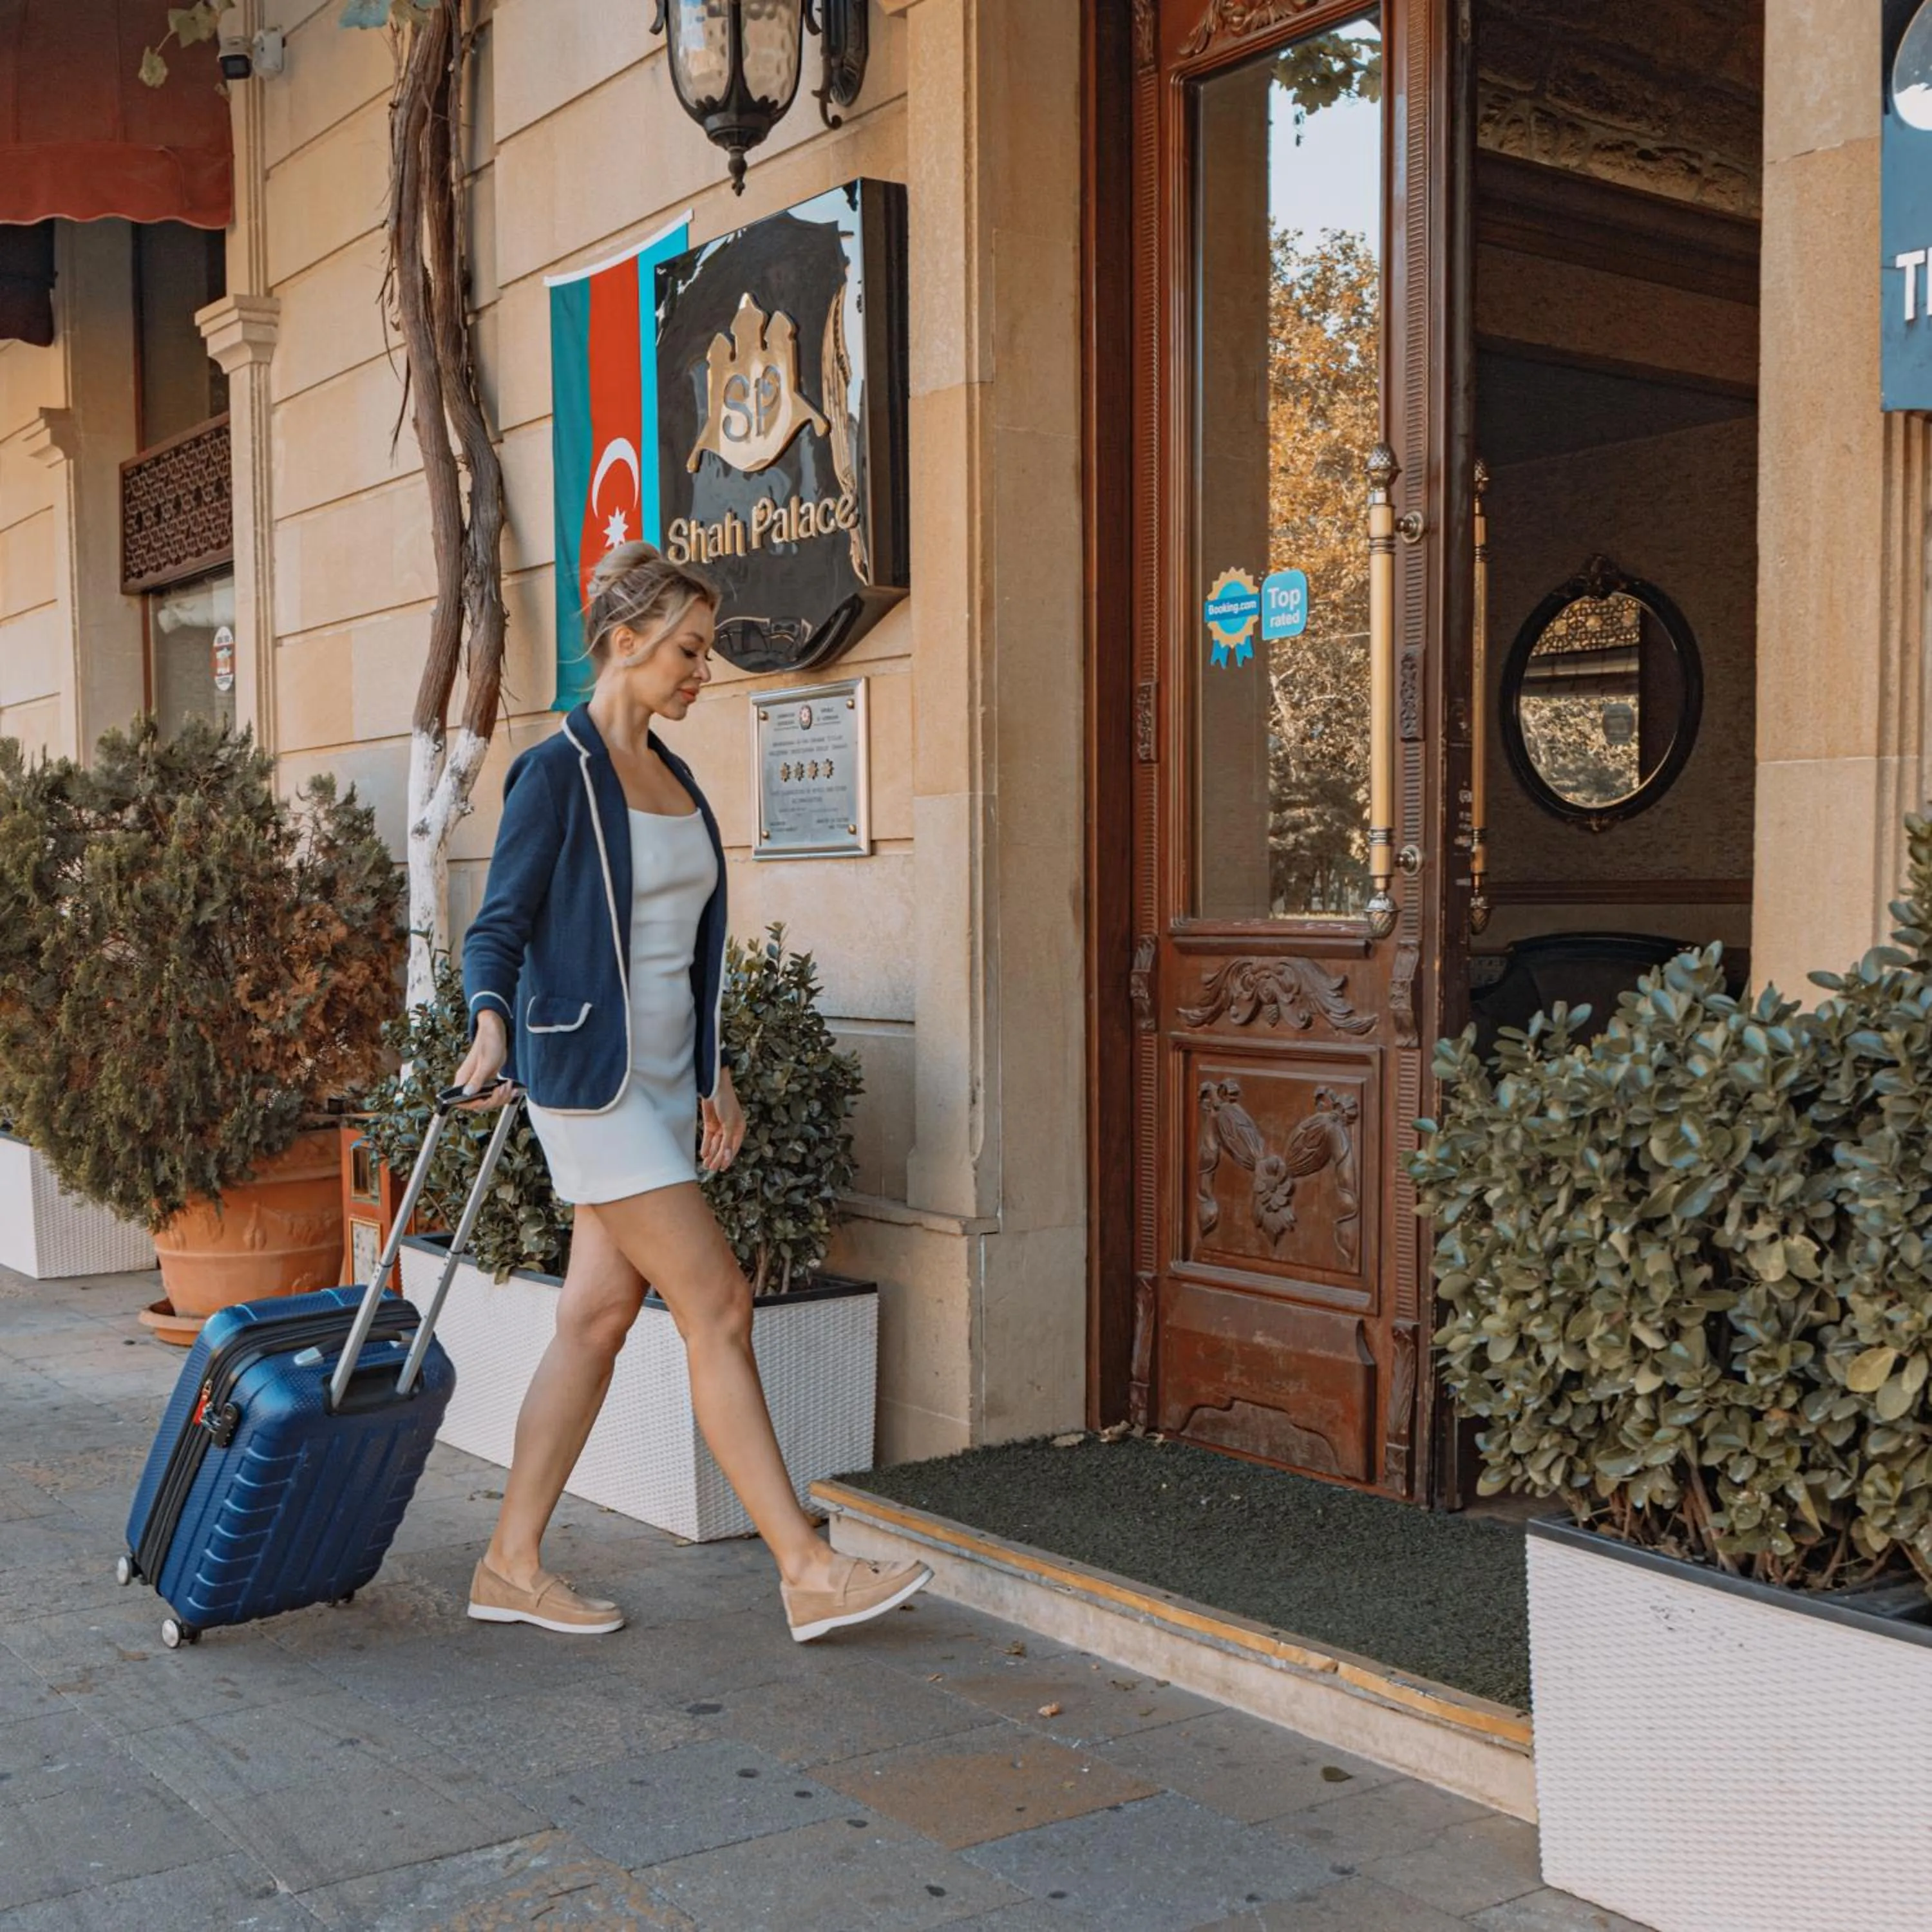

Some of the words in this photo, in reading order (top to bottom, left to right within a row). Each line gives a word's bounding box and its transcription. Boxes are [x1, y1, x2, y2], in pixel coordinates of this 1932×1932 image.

[723, 365, 781, 443] SP
[668, 511, 747, 565] Shah
[751, 493, 858, 549] Palace
[1208, 600, 1257, 616] Booking.com
[1267, 587, 1302, 611] Top
[1269, 609, 1300, 629] rated
